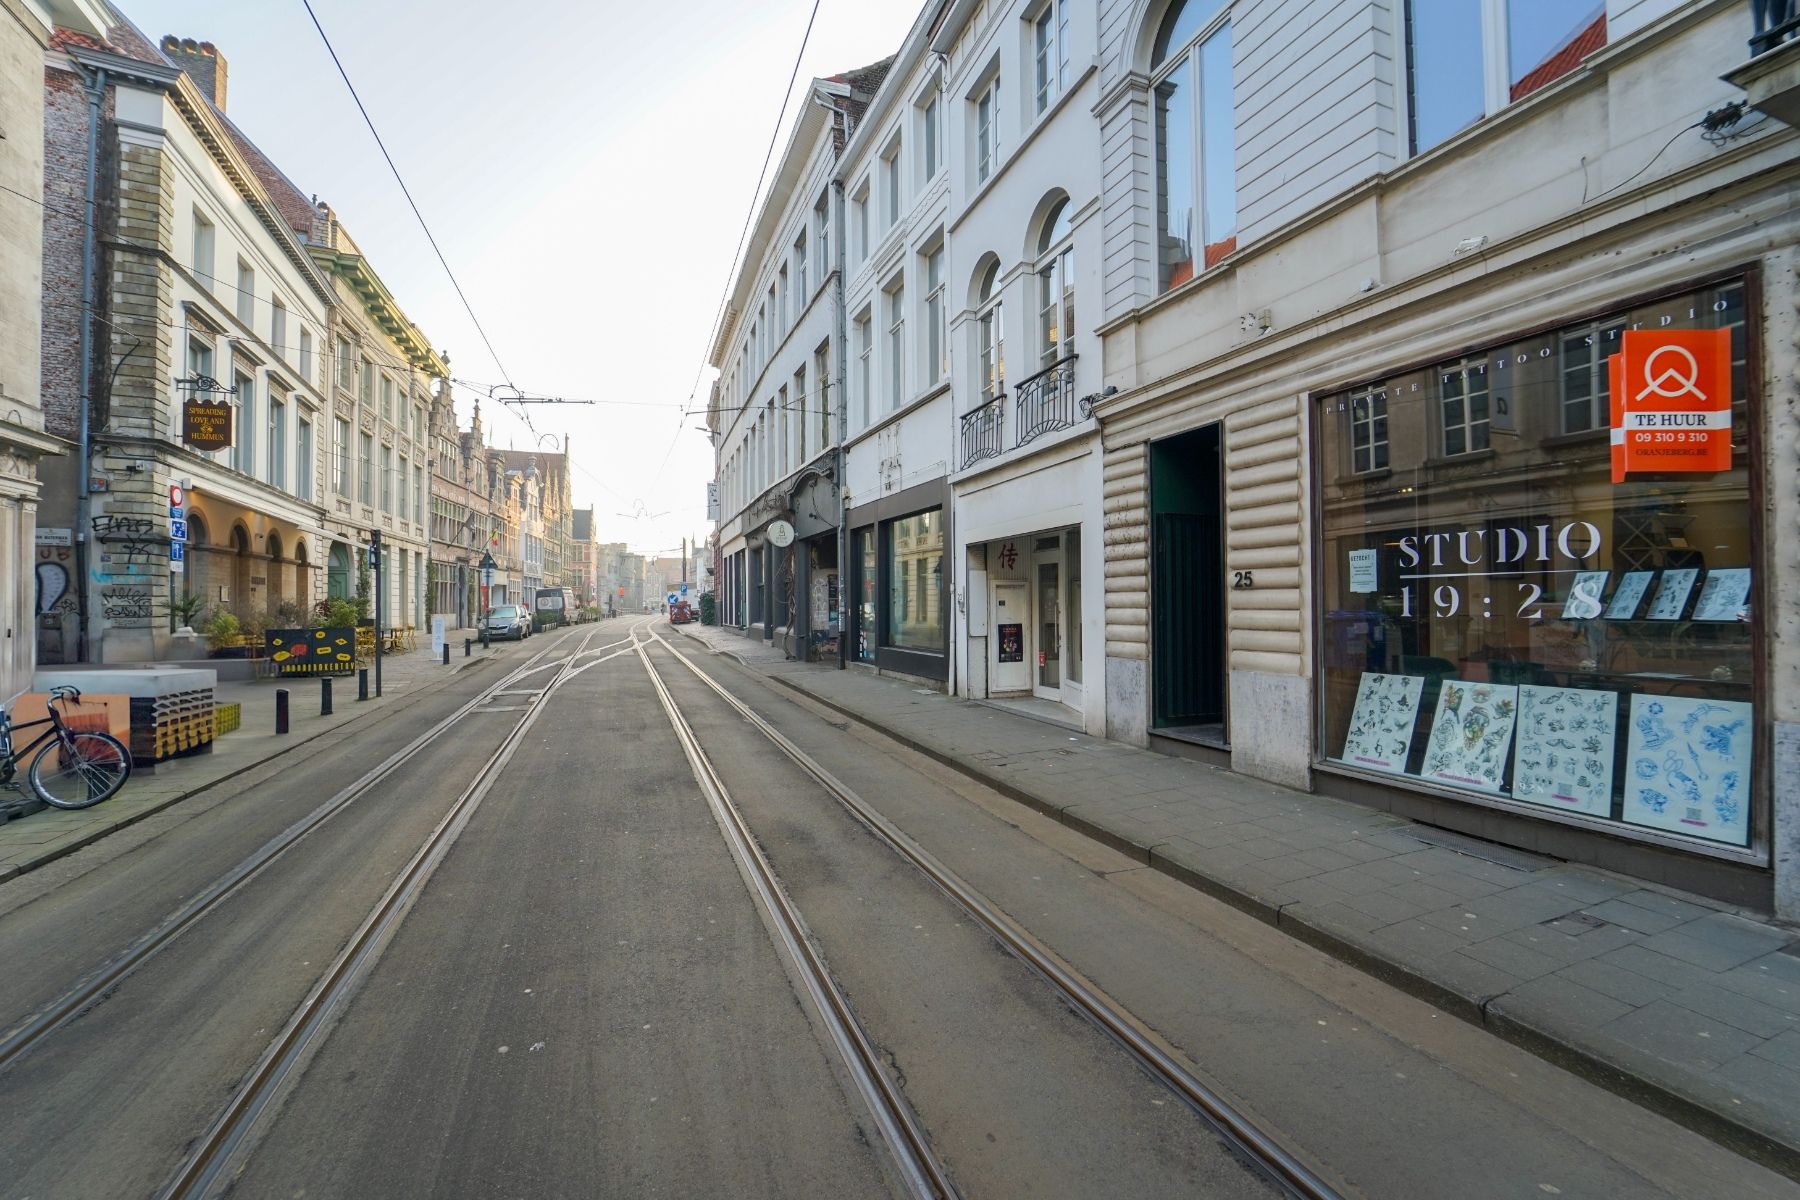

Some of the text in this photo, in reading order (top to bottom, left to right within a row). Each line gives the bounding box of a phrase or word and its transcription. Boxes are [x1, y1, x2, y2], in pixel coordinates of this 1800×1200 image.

[1326, 383, 1418, 414] PRIVATE
[1442, 348, 1550, 383] TATTOO
[189, 407, 226, 415] SPREADING
[190, 416, 225, 425] LOVE AND
[1635, 414, 1707, 426] TE HUUR
[191, 432, 224, 440] HUMMUS
[1635, 432, 1708, 442] 09 310 9 310
[1400, 521, 1600, 567] STUDIO
[999, 543, 1018, 570] 传
[1235, 571, 1253, 588] 25
